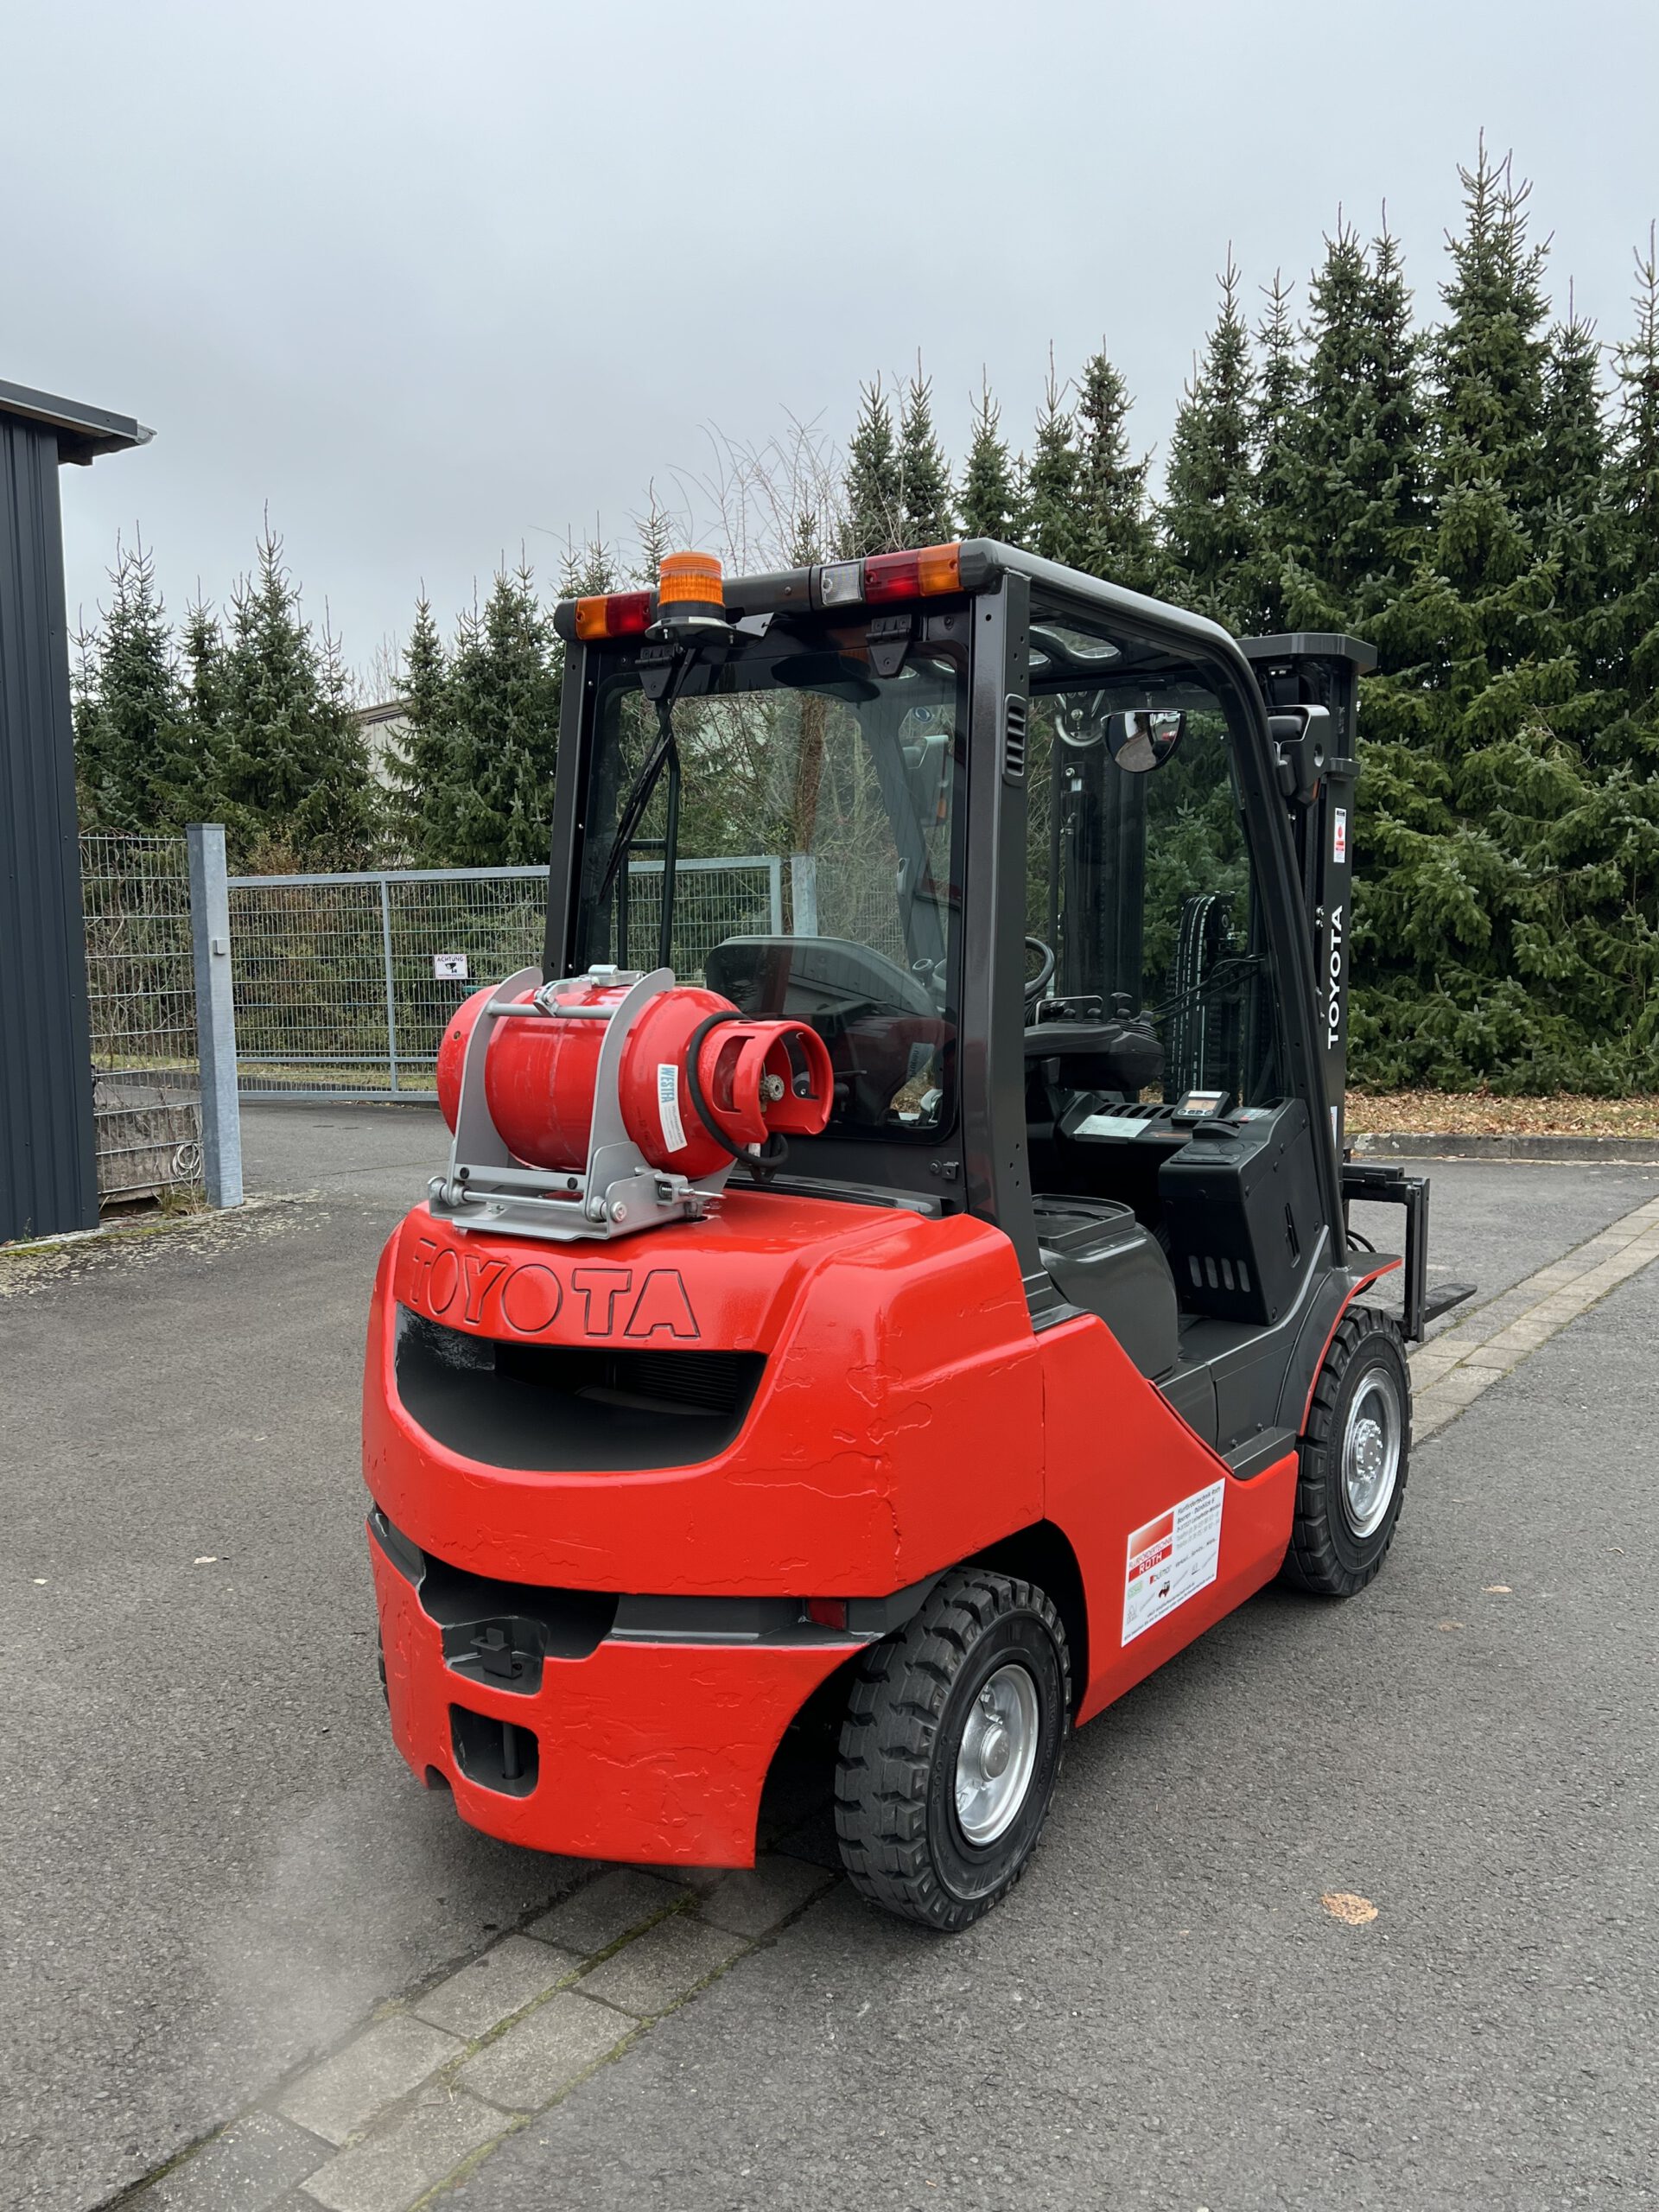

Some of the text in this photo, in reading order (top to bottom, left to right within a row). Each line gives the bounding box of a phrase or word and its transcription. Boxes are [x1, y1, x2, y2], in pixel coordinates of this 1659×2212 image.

[1328, 906, 1343, 1050] TOYOTA
[660, 1067, 676, 1103] WESTFA
[409, 1237, 701, 1339] TOYOTA
[1139, 1551, 1163, 1574] ROTH
